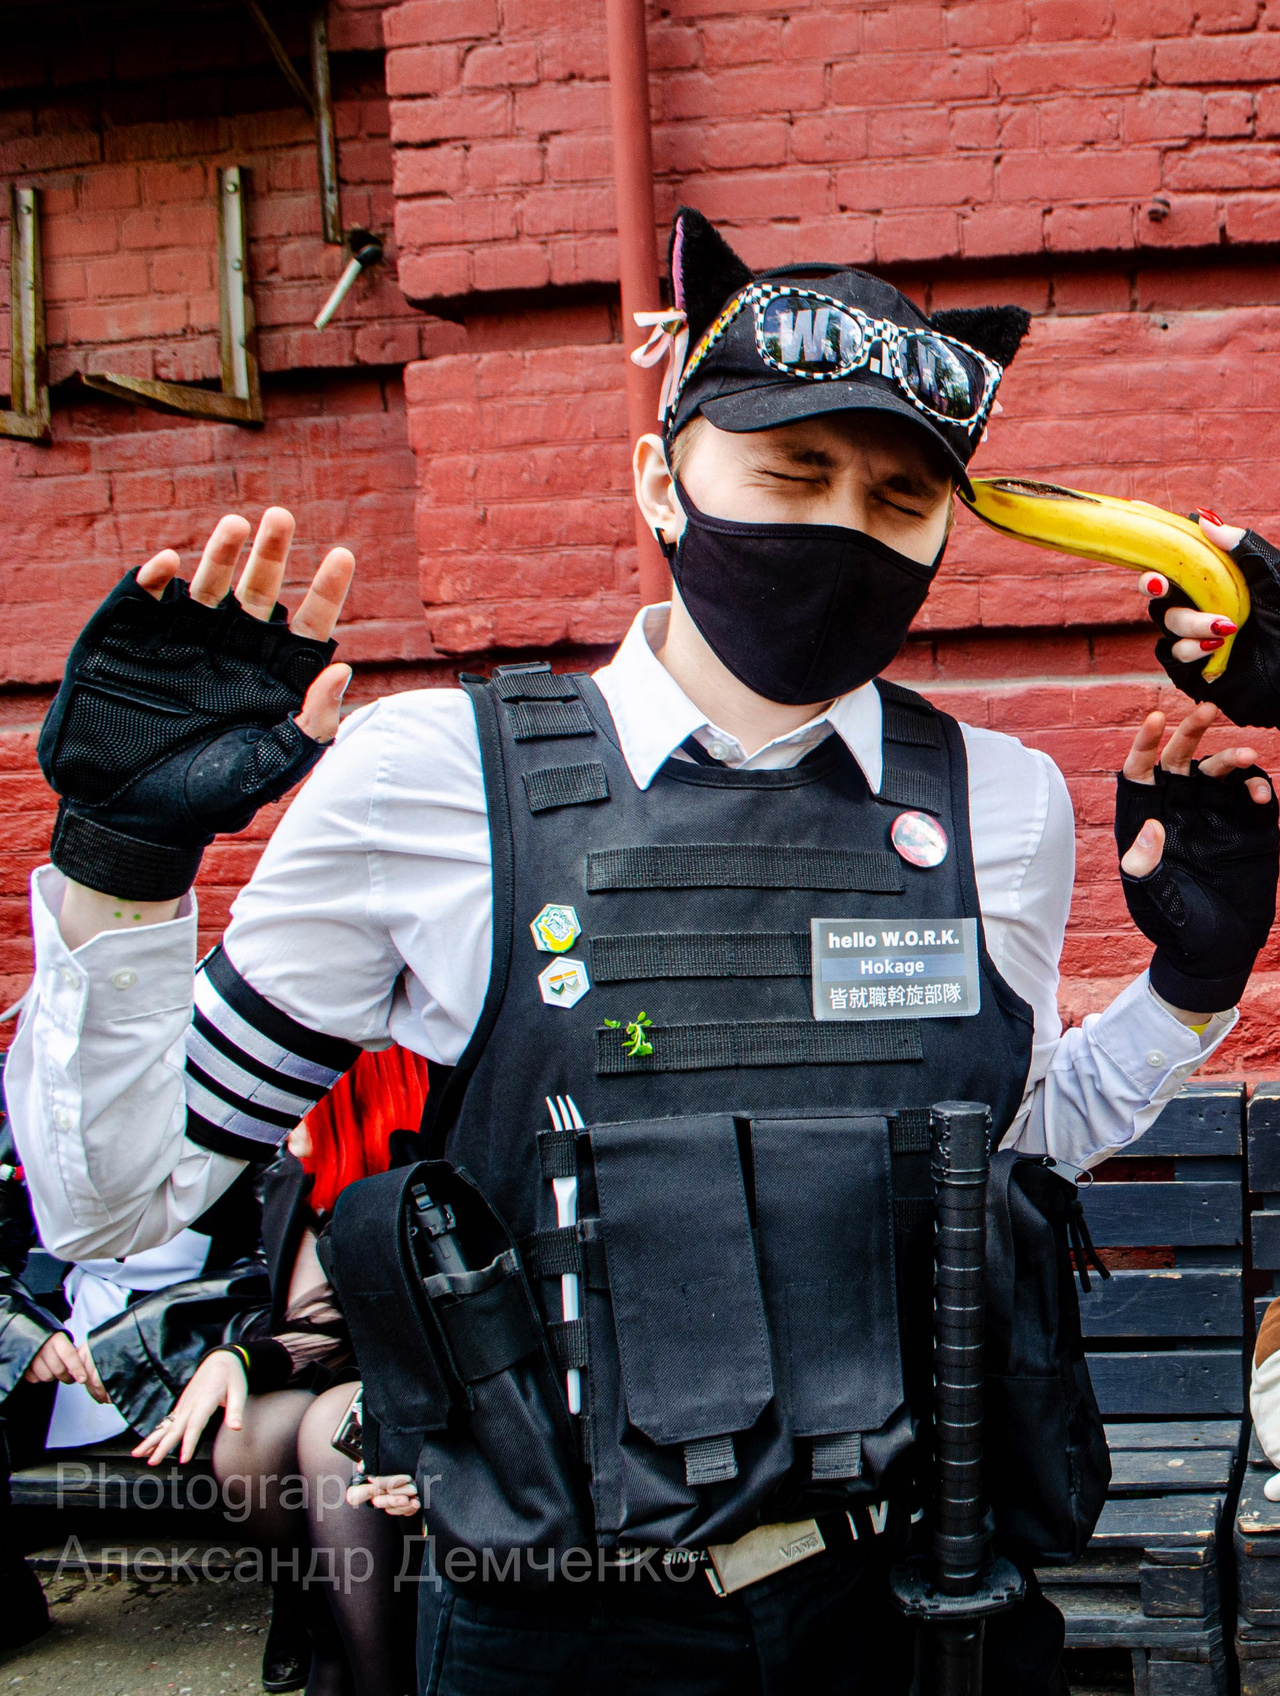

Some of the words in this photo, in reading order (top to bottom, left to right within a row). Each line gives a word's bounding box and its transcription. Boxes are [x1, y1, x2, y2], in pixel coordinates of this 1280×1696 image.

[828, 932, 877, 948] hello
[881, 929, 960, 947] W.O.R.K.
[860, 959, 925, 977] Hokage
